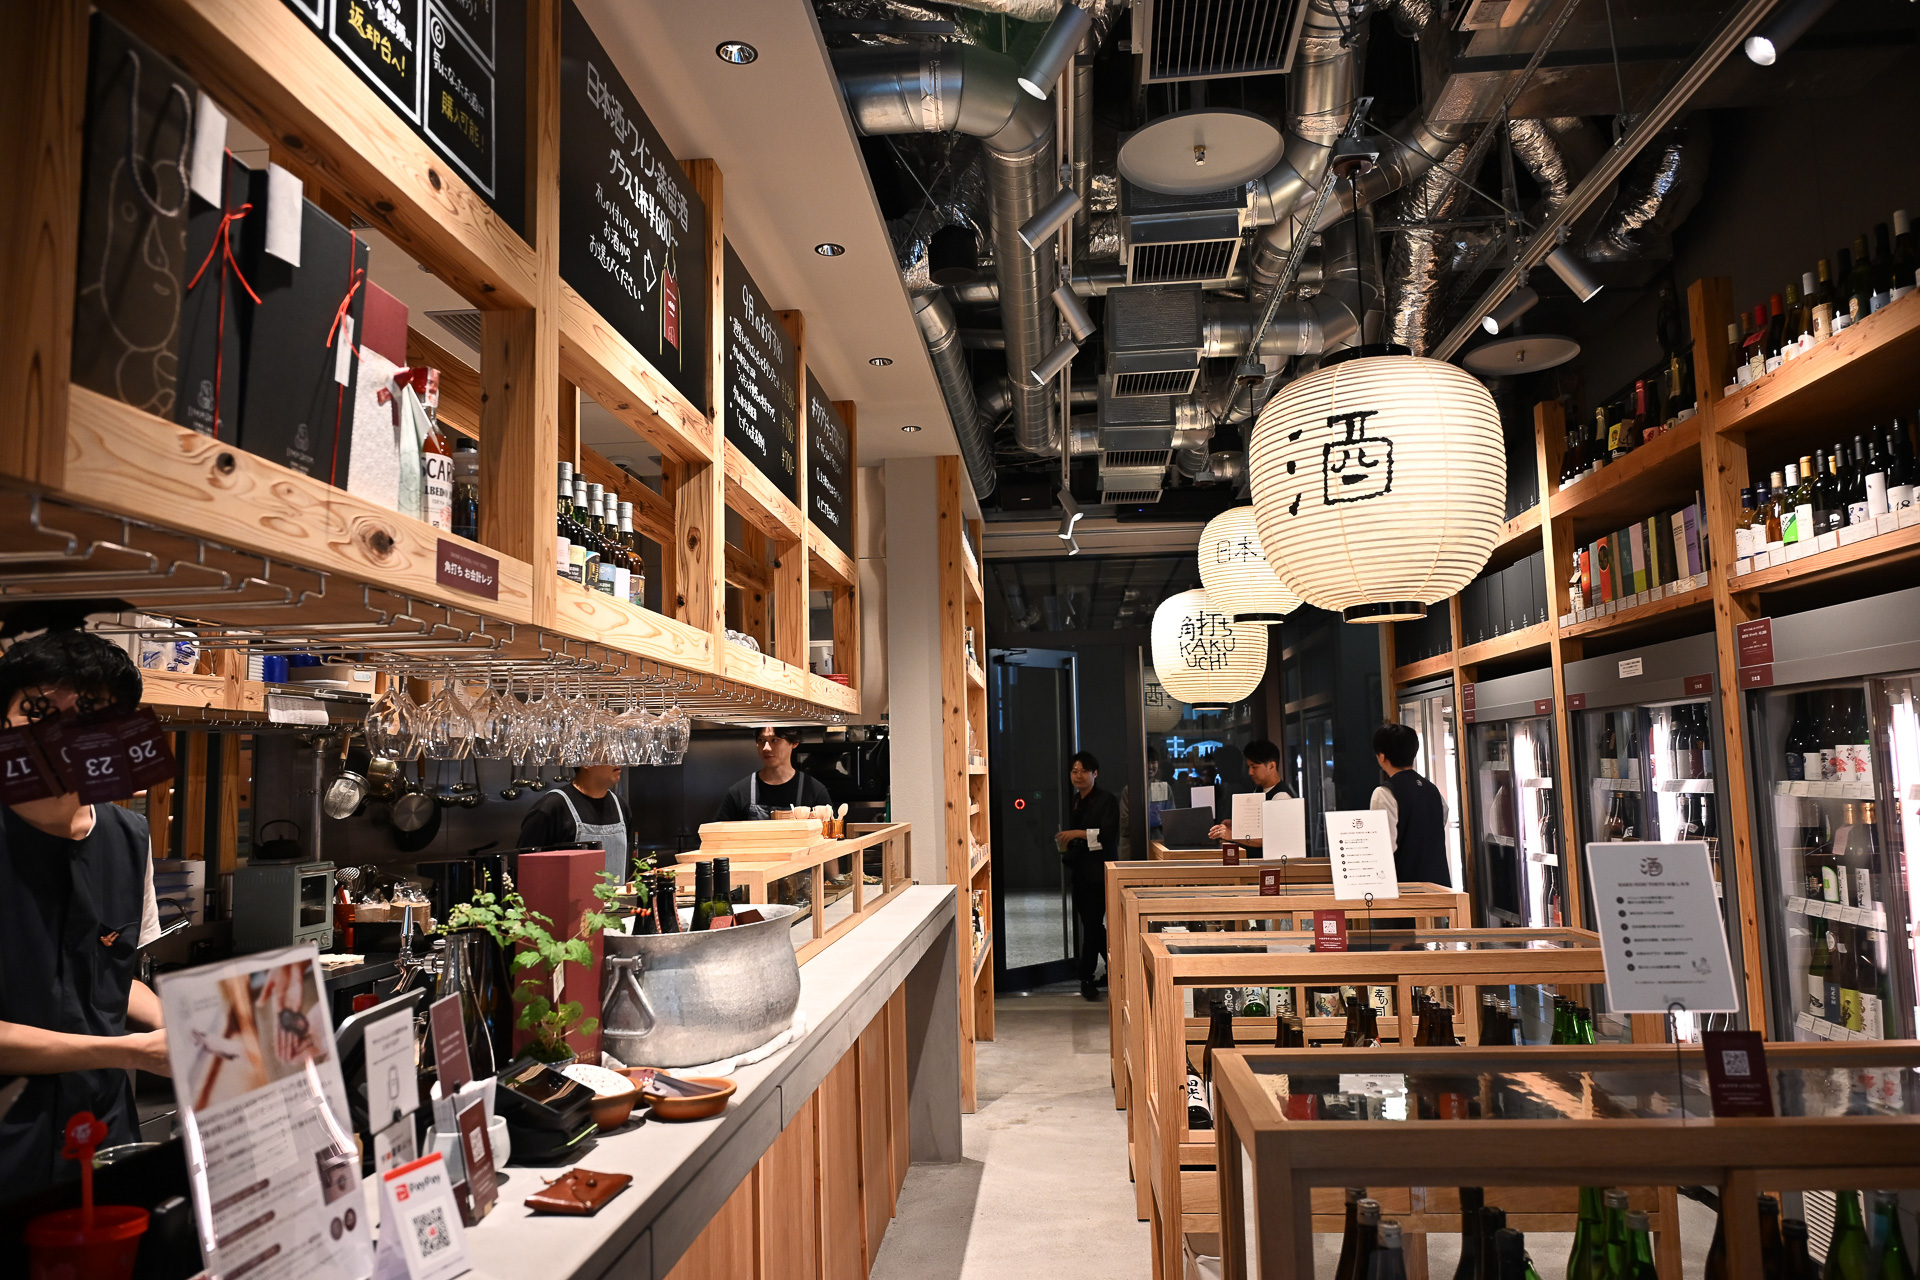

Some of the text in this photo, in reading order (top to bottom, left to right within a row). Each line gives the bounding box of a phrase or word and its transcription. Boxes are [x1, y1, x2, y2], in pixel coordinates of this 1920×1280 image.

[1286, 410, 1393, 516] 酒
[1217, 536, 1267, 563] 日本
[444, 560, 464, 577] 角打ち
[464, 567, 493, 586] お会計レジ
[1177, 610, 1233, 641] 角打ち
[1179, 637, 1236, 657] KAKU
[1185, 653, 1229, 671] UCHI
[128, 740, 157, 763] 26
[85, 756, 114, 777] 23
[1640, 856, 1663, 877] 酒
[409, 1173, 441, 1194] PayPay
